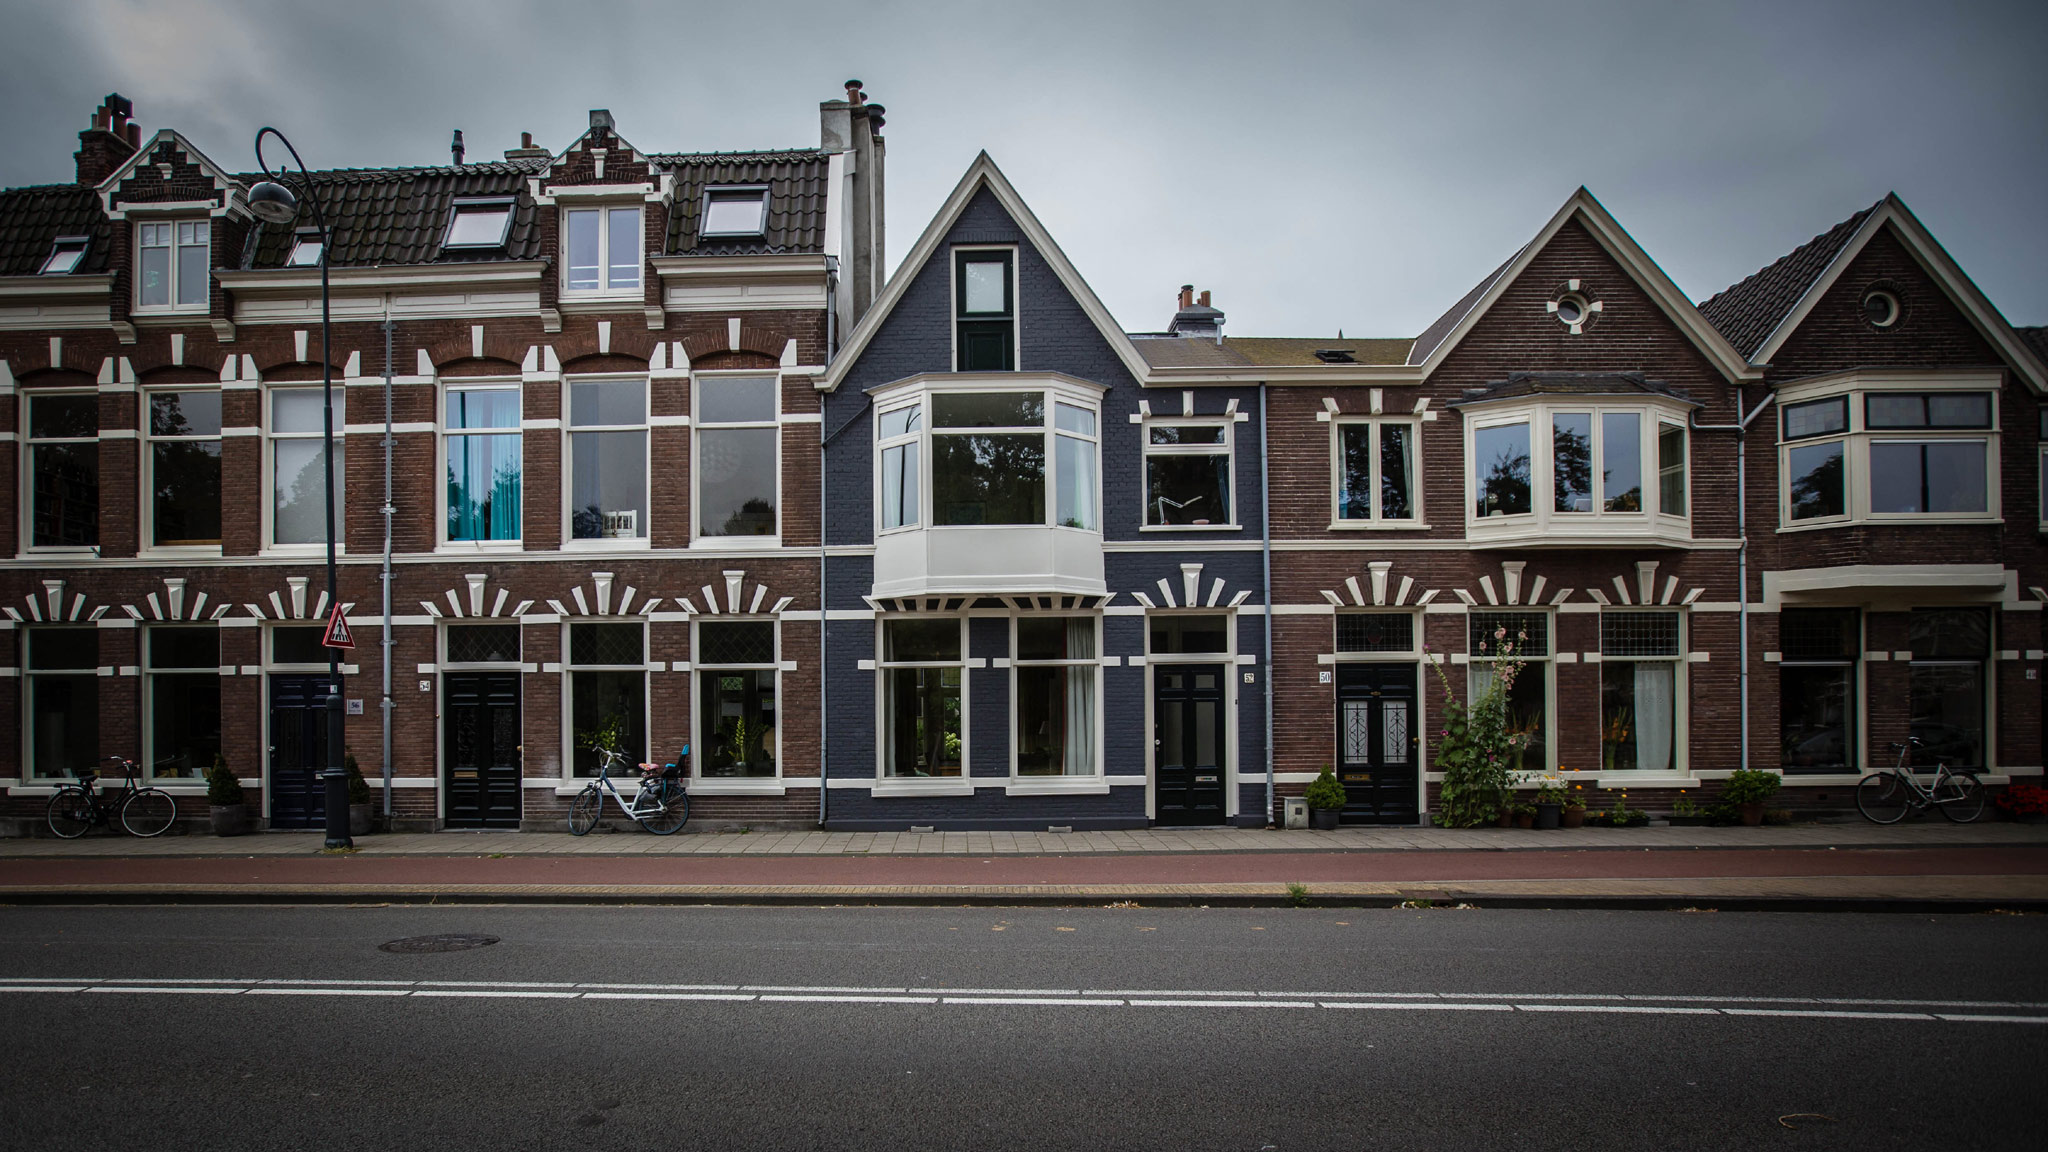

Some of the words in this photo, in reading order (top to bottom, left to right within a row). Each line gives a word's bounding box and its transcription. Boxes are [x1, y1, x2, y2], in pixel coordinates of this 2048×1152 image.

[1244, 673, 1254, 683] 52
[1320, 672, 1331, 683] 50
[420, 681, 430, 691] 54
